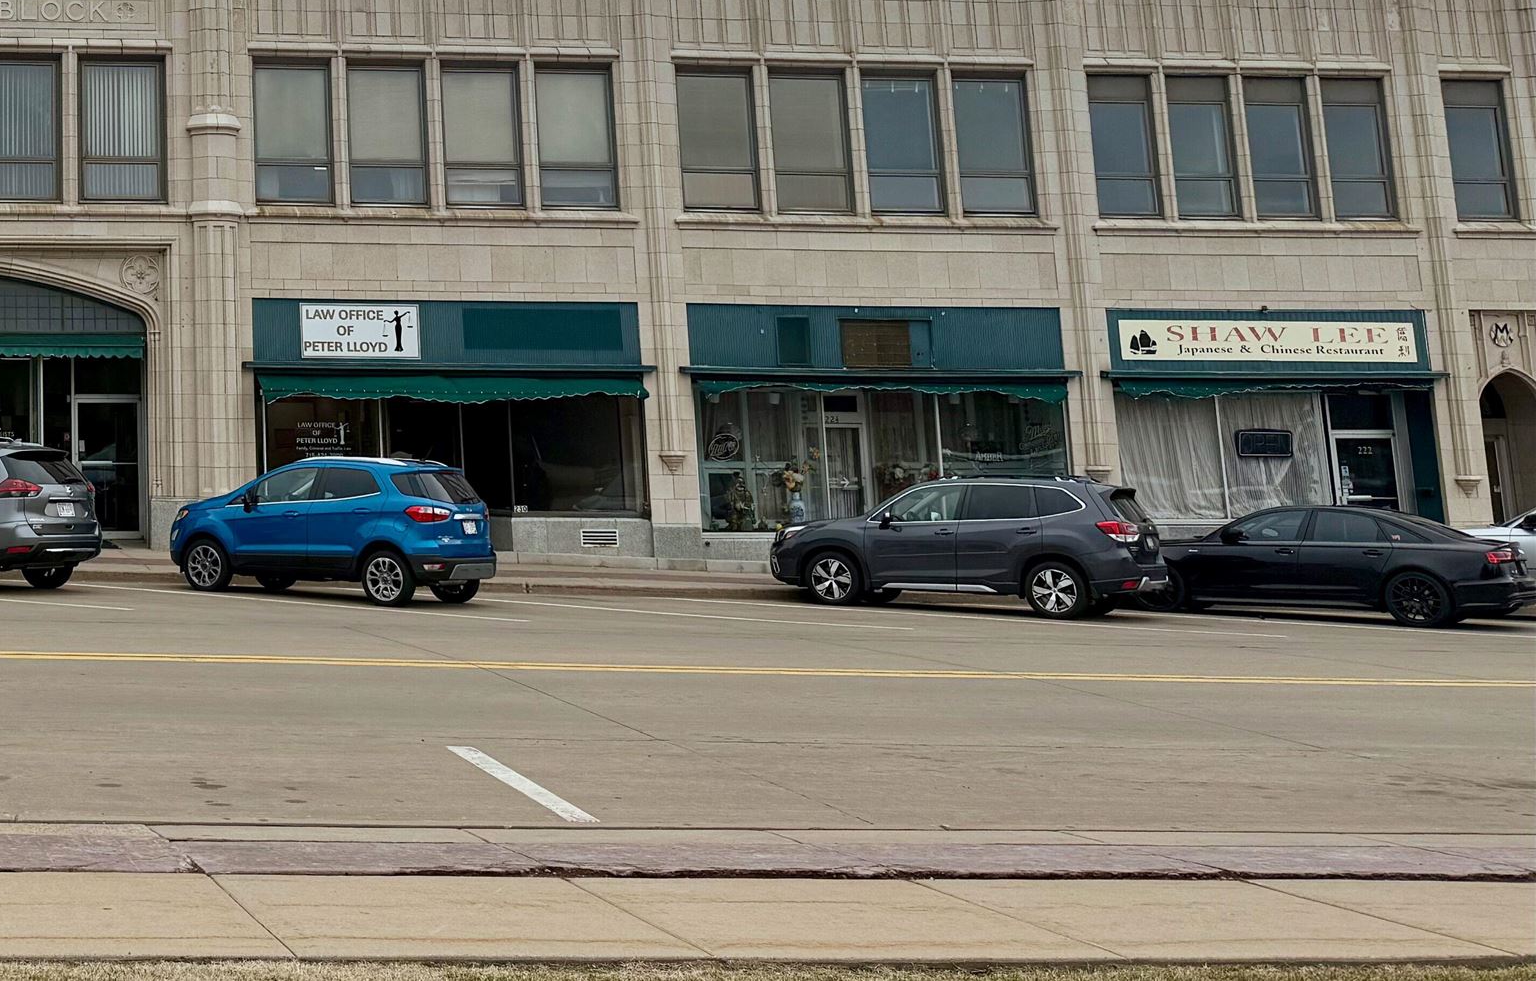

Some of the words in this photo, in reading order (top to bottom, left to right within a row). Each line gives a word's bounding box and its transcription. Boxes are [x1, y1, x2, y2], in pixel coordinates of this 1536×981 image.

[305, 309, 336, 320] LAW
[338, 309, 384, 321] OFFICE
[336, 325, 355, 336] OF
[1166, 324, 1288, 342] SHAW
[1309, 326, 1390, 344] LEE
[304, 341, 344, 352] PETER
[346, 341, 388, 353] LLOYD
[1177, 344, 1233, 356] Japanese
[1239, 345, 1252, 354] &
[1260, 344, 1312, 355] Chinese
[1315, 345, 1385, 356] Restaurant
[1357, 446, 1373, 455] 222
